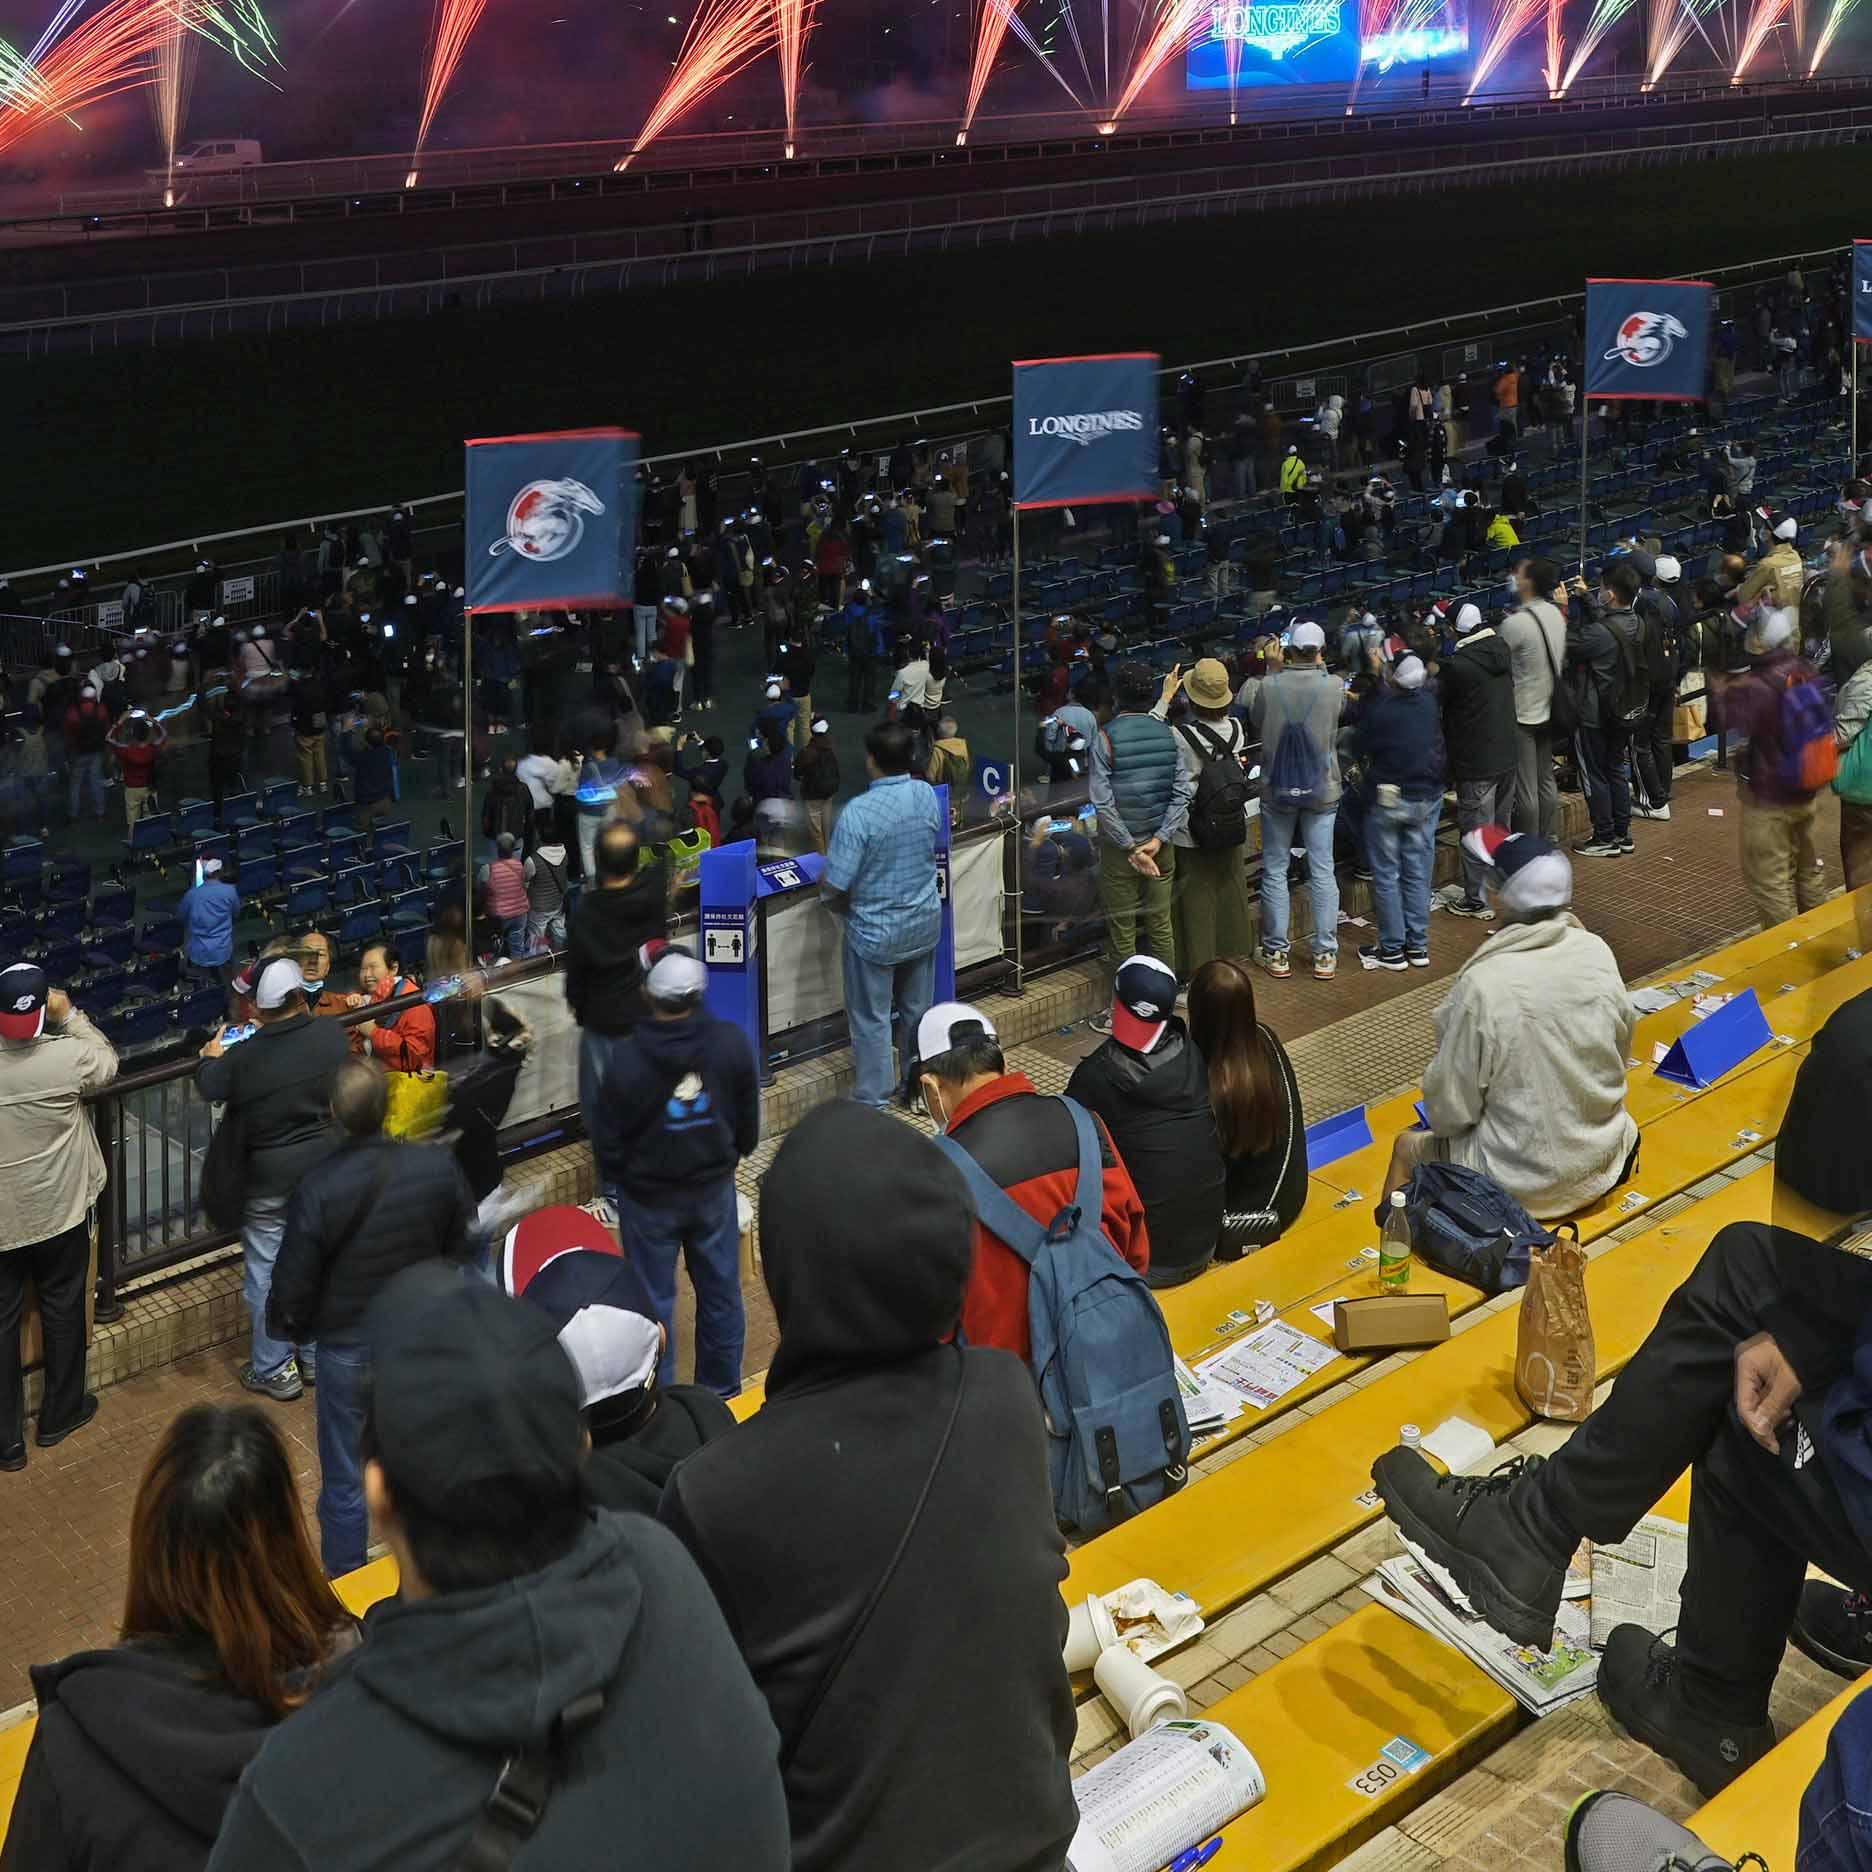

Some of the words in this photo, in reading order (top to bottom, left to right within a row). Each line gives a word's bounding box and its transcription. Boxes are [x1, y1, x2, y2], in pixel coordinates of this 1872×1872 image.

[1210, 3, 1341, 39] LONGINES
[1029, 409, 1143, 436] LONGINES
[982, 767, 1002, 796] C
[1215, 1321, 1235, 1334] 048
[1356, 1491, 1378, 1505] 51
[1355, 1762, 1397, 1794] 053
